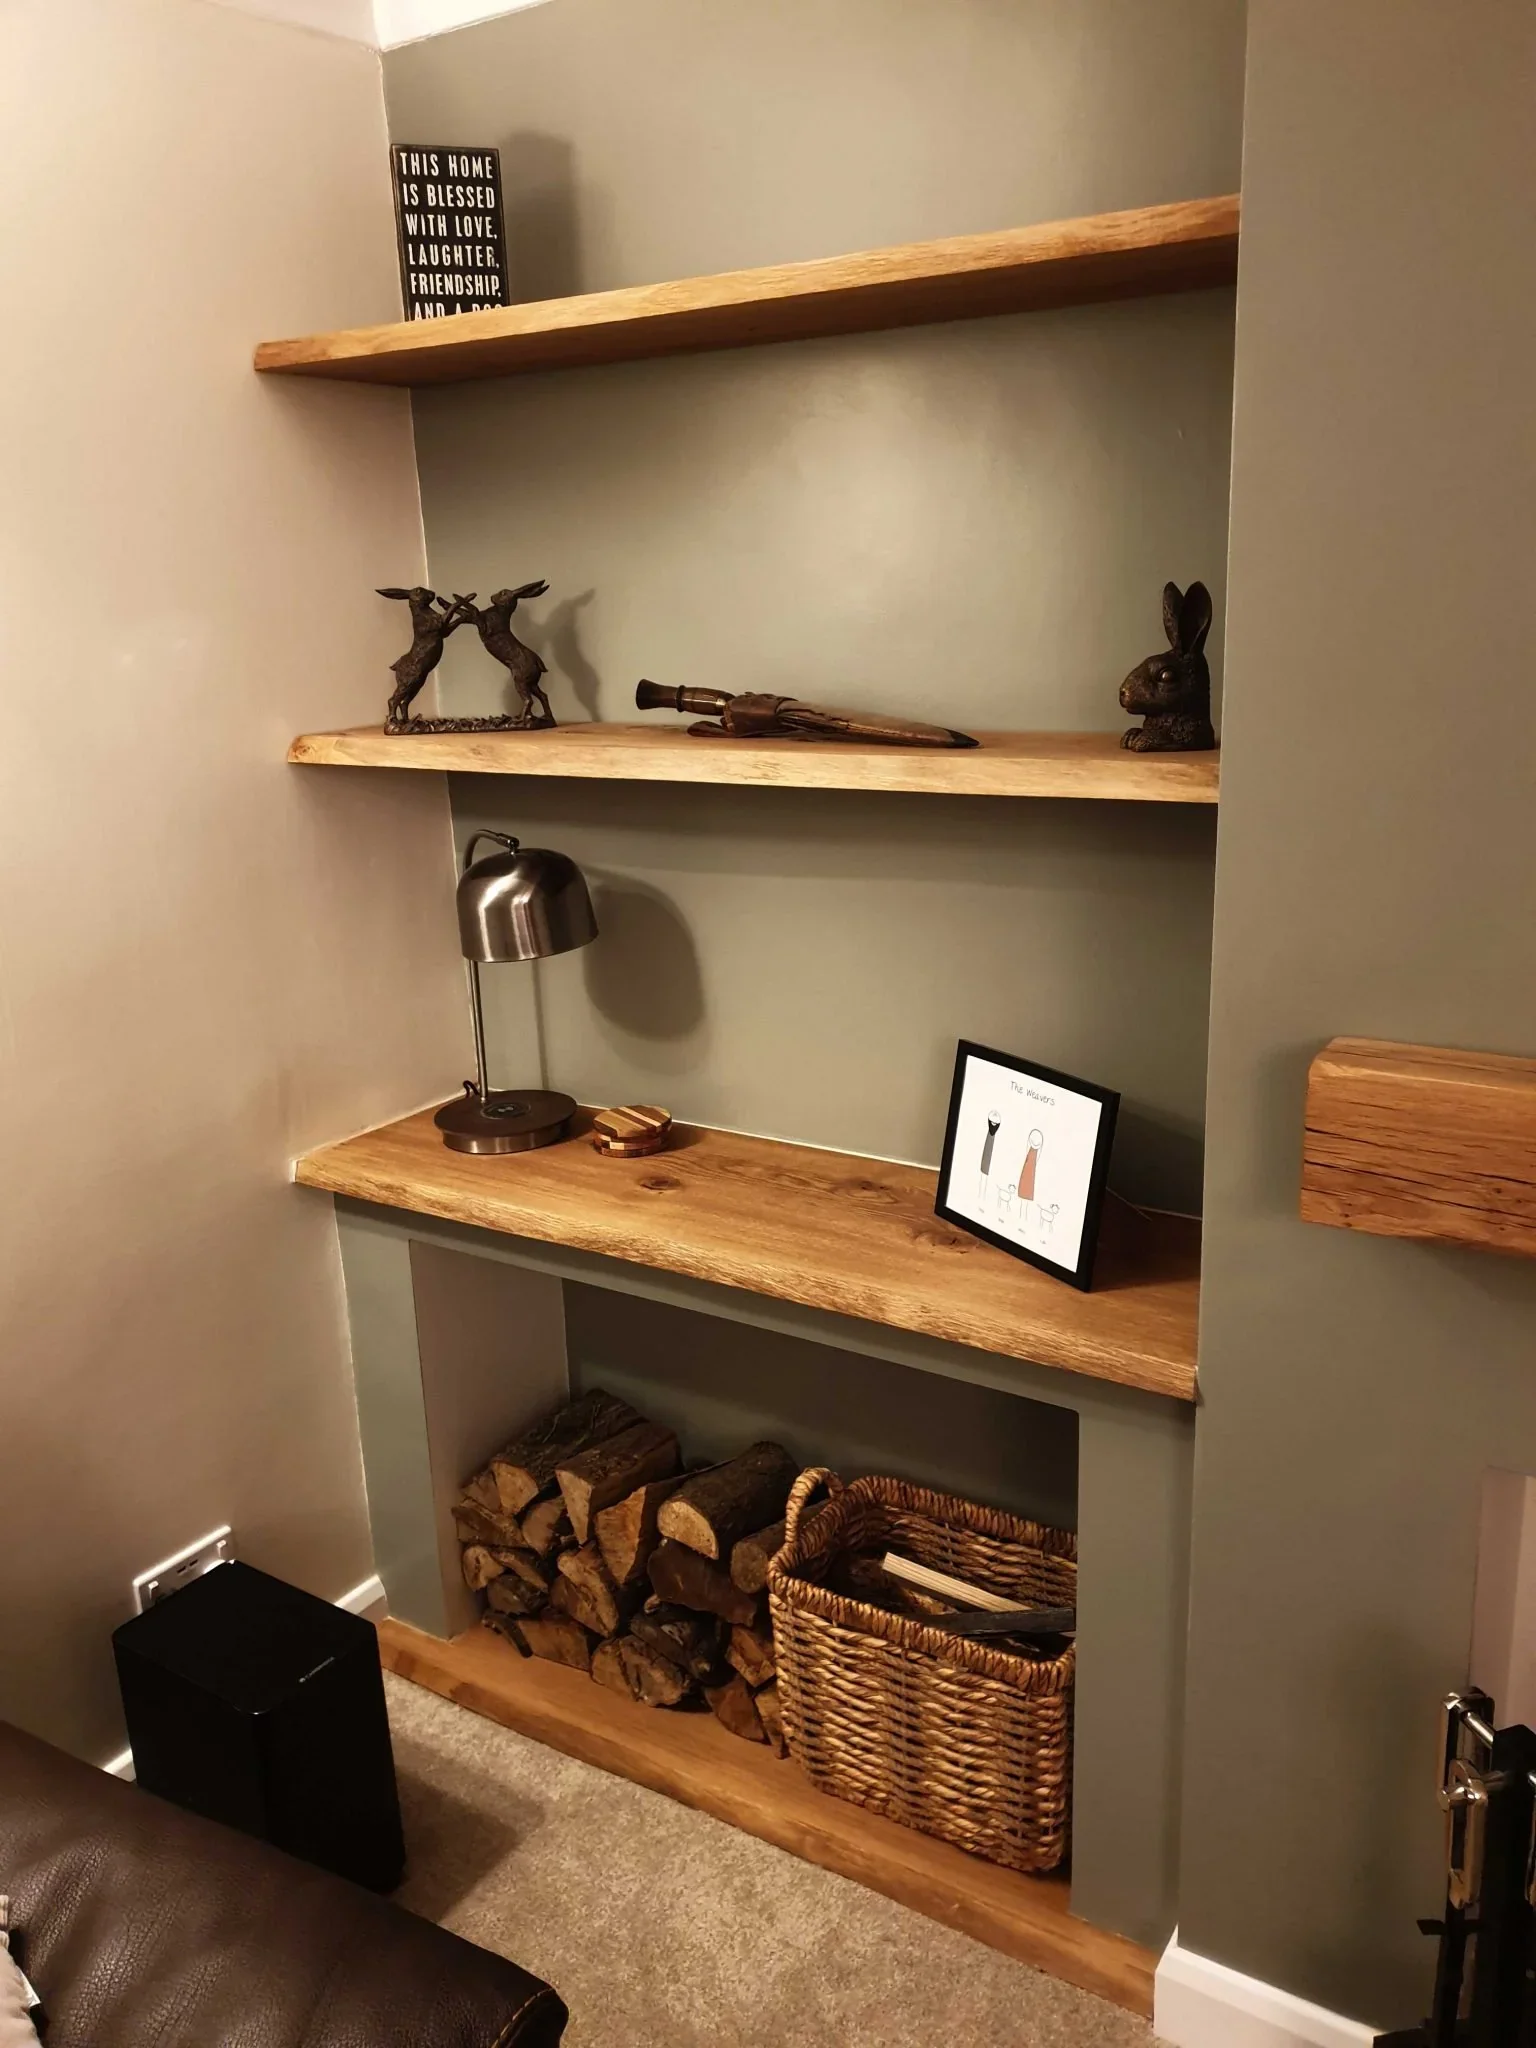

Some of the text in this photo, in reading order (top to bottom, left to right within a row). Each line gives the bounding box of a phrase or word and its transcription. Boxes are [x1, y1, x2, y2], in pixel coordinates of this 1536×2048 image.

[400, 152, 493, 179] THIS HOME
[402, 183, 495, 209] IS BLESSED
[405, 213, 497, 239] WITH LOVE,
[408, 243, 499, 268] LAUGHTER,
[410, 273, 501, 297] FRIENDSHIP,
[414, 302, 446, 320] AND
[1010, 1081, 1023, 1094] The
